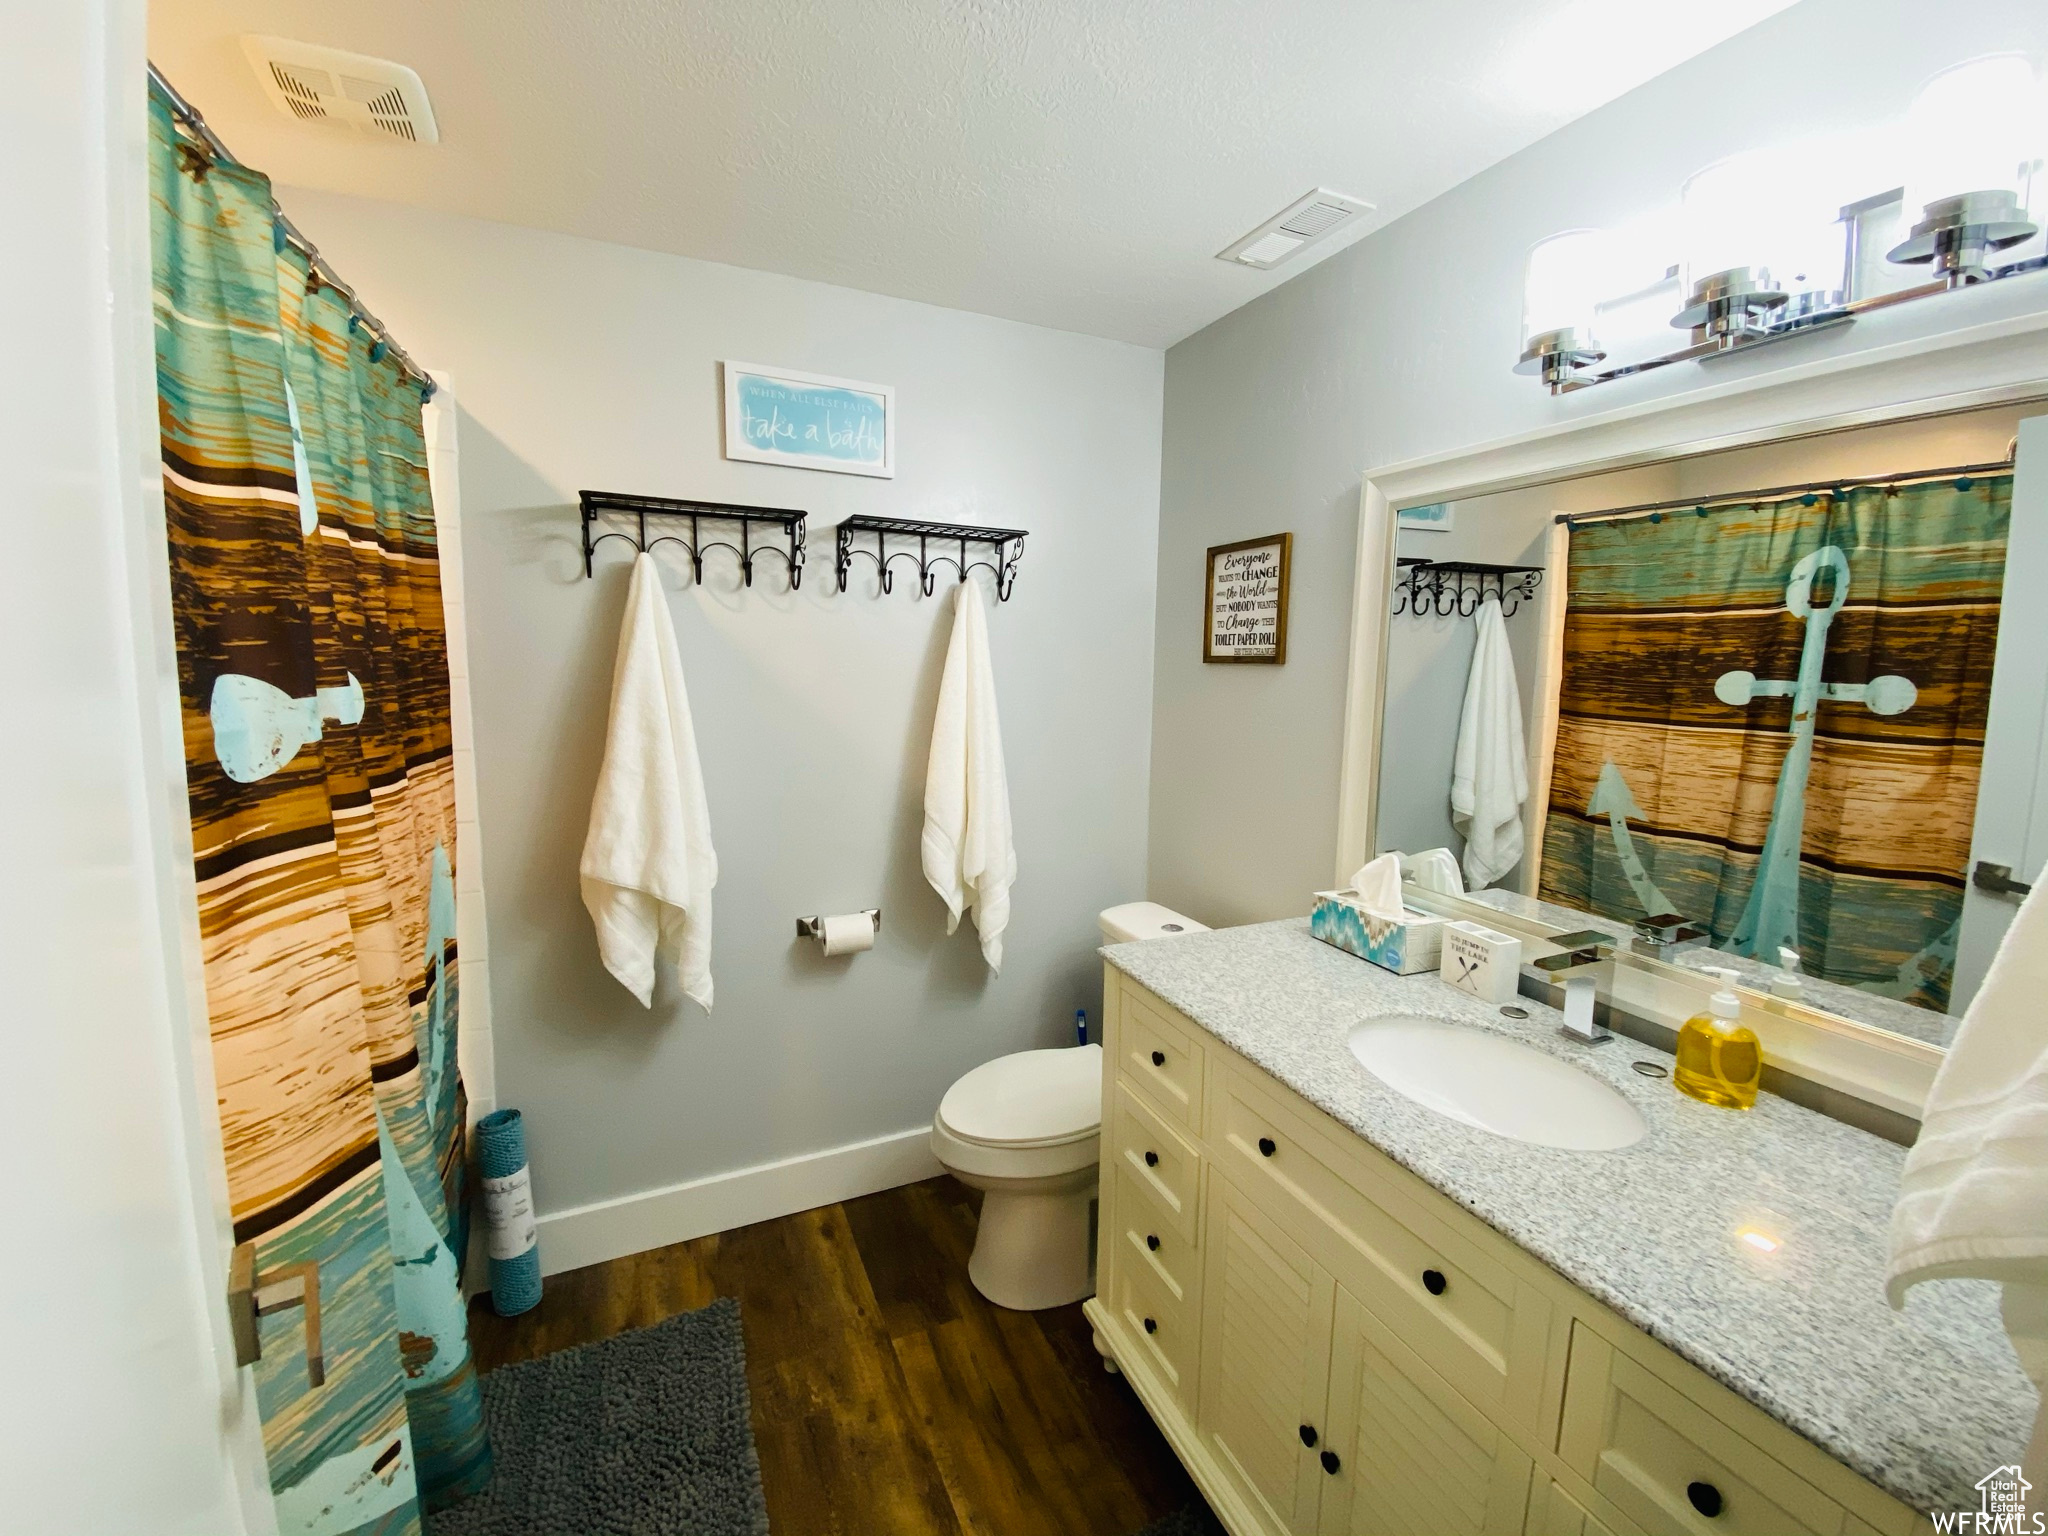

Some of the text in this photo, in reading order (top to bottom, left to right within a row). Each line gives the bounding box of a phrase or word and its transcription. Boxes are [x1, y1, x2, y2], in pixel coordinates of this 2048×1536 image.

[750, 387, 786, 400] WHEN
[791, 394, 809, 405] ALL
[815, 397, 840, 409] ELSE
[743, 404, 879, 461] take a bath
[1224, 552, 1273, 570] Everyone
[1218, 566, 1278, 583] WANTS TO CHANGE
[1226, 580, 1267, 600] the World
[1216, 600, 1278, 613] BUT NOBODY WANTS
[1217, 613, 1275, 632] TO Change THE
[1214, 632, 1276, 646] TOILET PAPER ROLL
[1450, 942, 1489, 964] THE LAKE
